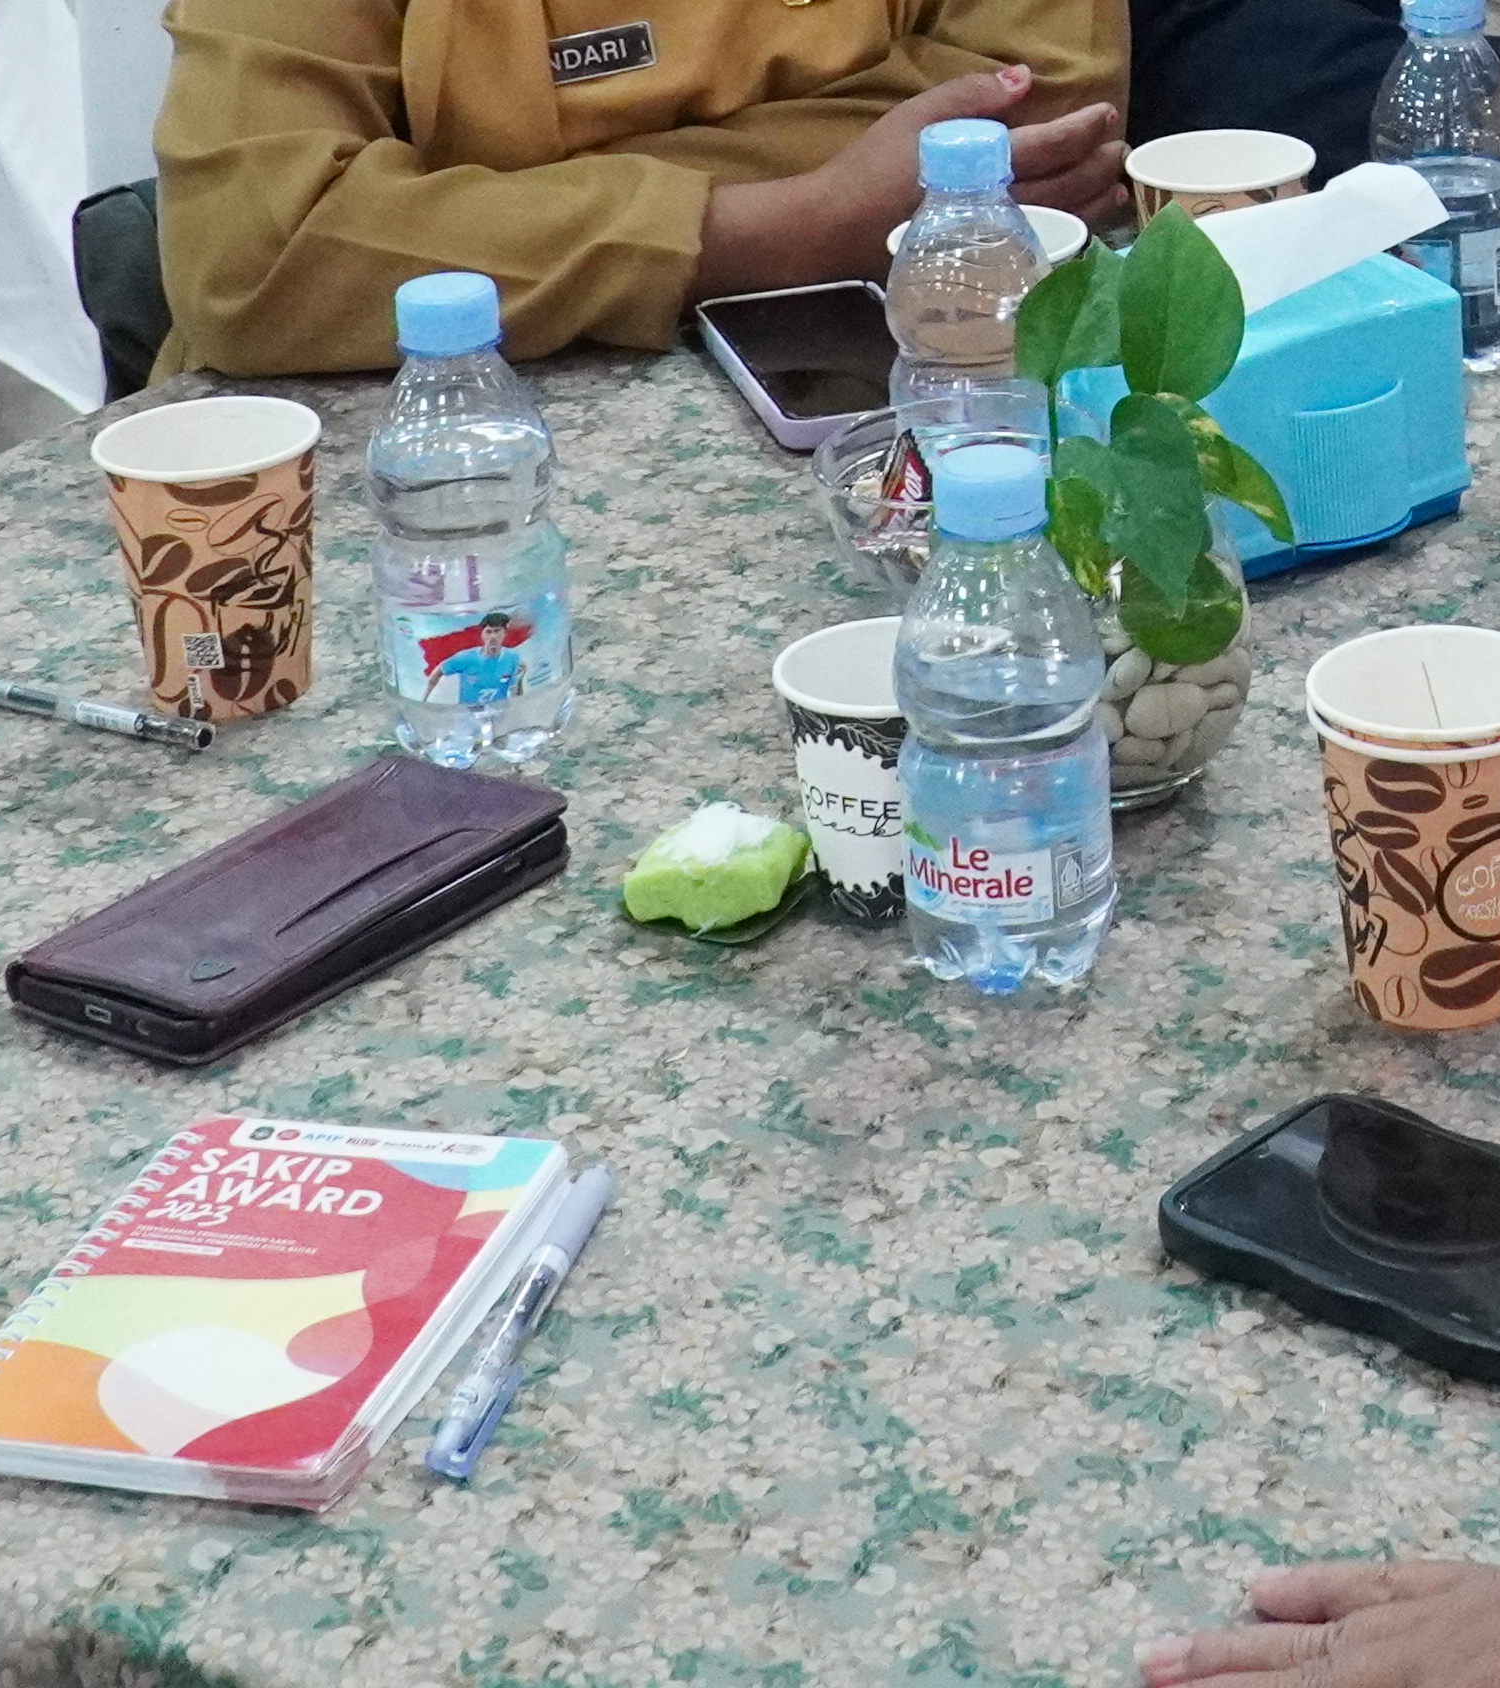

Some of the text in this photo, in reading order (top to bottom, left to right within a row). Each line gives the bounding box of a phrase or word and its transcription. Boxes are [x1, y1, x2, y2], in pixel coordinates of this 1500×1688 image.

[951, 835, 989, 871] Le
[909, 847, 1034, 900] Minerale
[190, 1147, 353, 1186] SAKIP
[145, 1199, 235, 1228] 2023
[165, 1174, 384, 1217] AWARD
